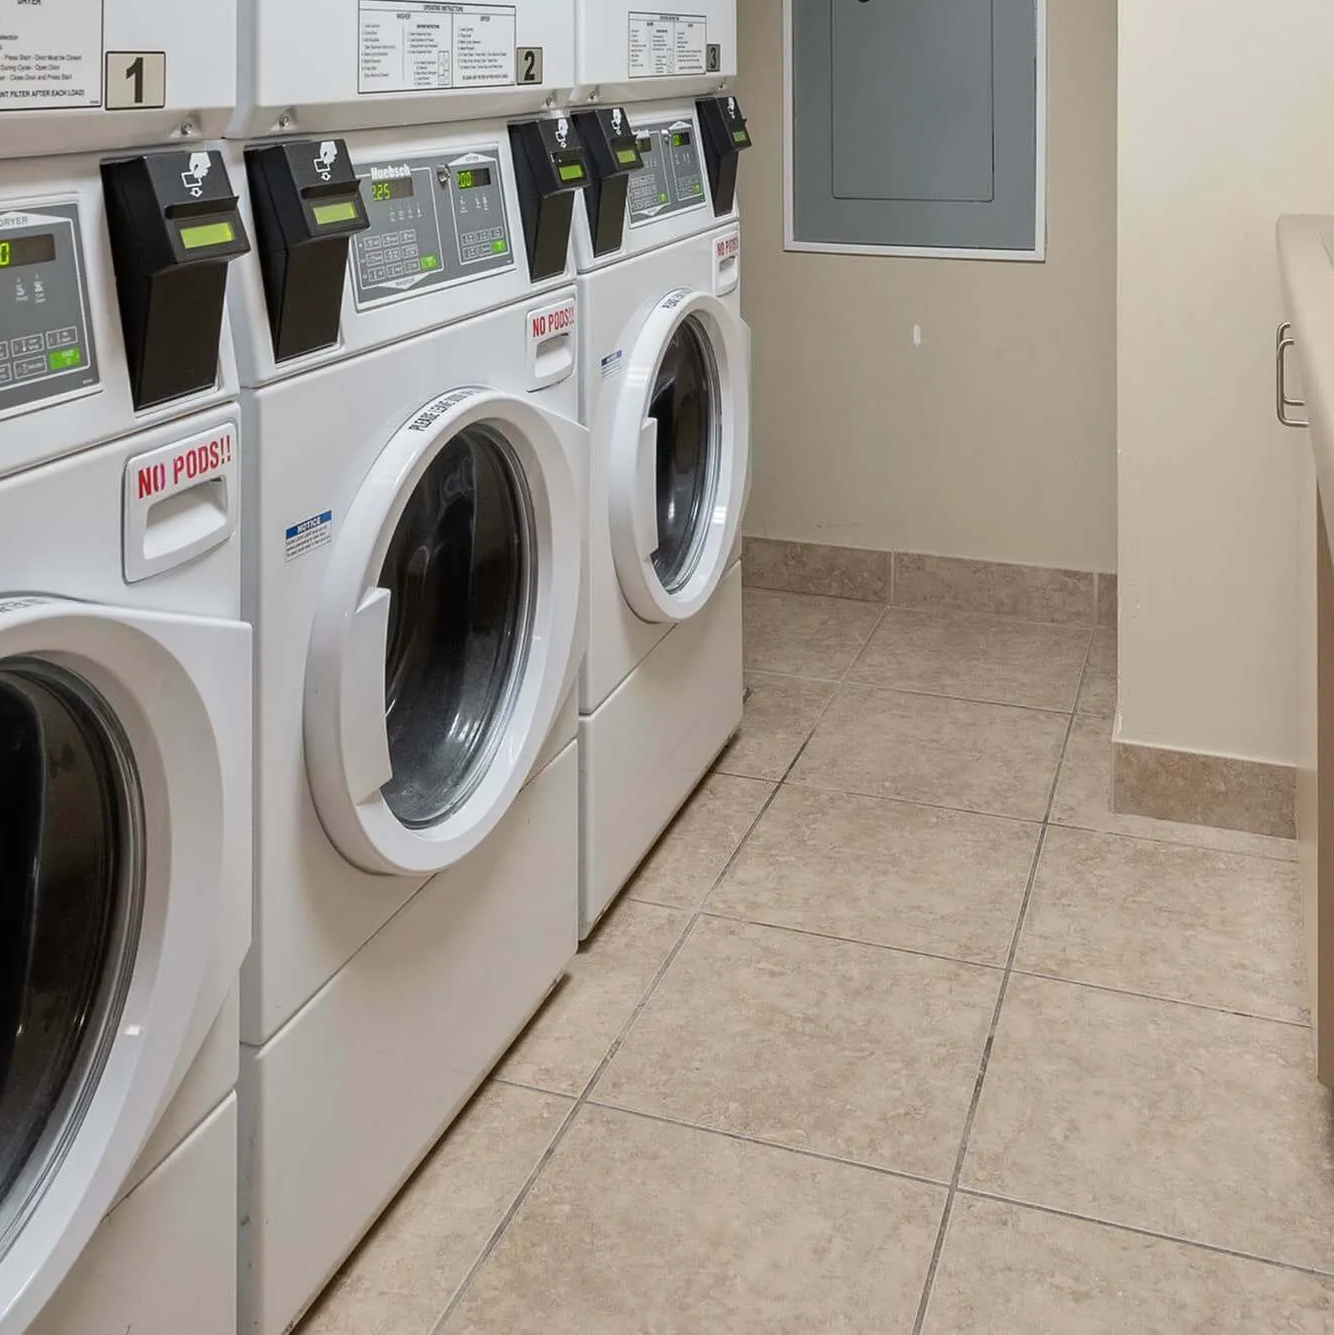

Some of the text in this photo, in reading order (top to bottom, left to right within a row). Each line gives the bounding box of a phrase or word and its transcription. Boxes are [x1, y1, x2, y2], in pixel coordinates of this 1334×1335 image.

[524, 50, 535, 81] 2
[710, 47, 716, 69] 3
[126, 56, 144, 104] 1
[10, 90, 30, 98] FILTER
[31, 90, 51, 98] AFTER
[68, 89, 84, 97] LOAD)
[371, 163, 411, 180] Huebsch
[533, 316, 546, 337] NO
[138, 435, 231, 499] NO PODS!!
[297, 516, 322, 534] NOTICE
